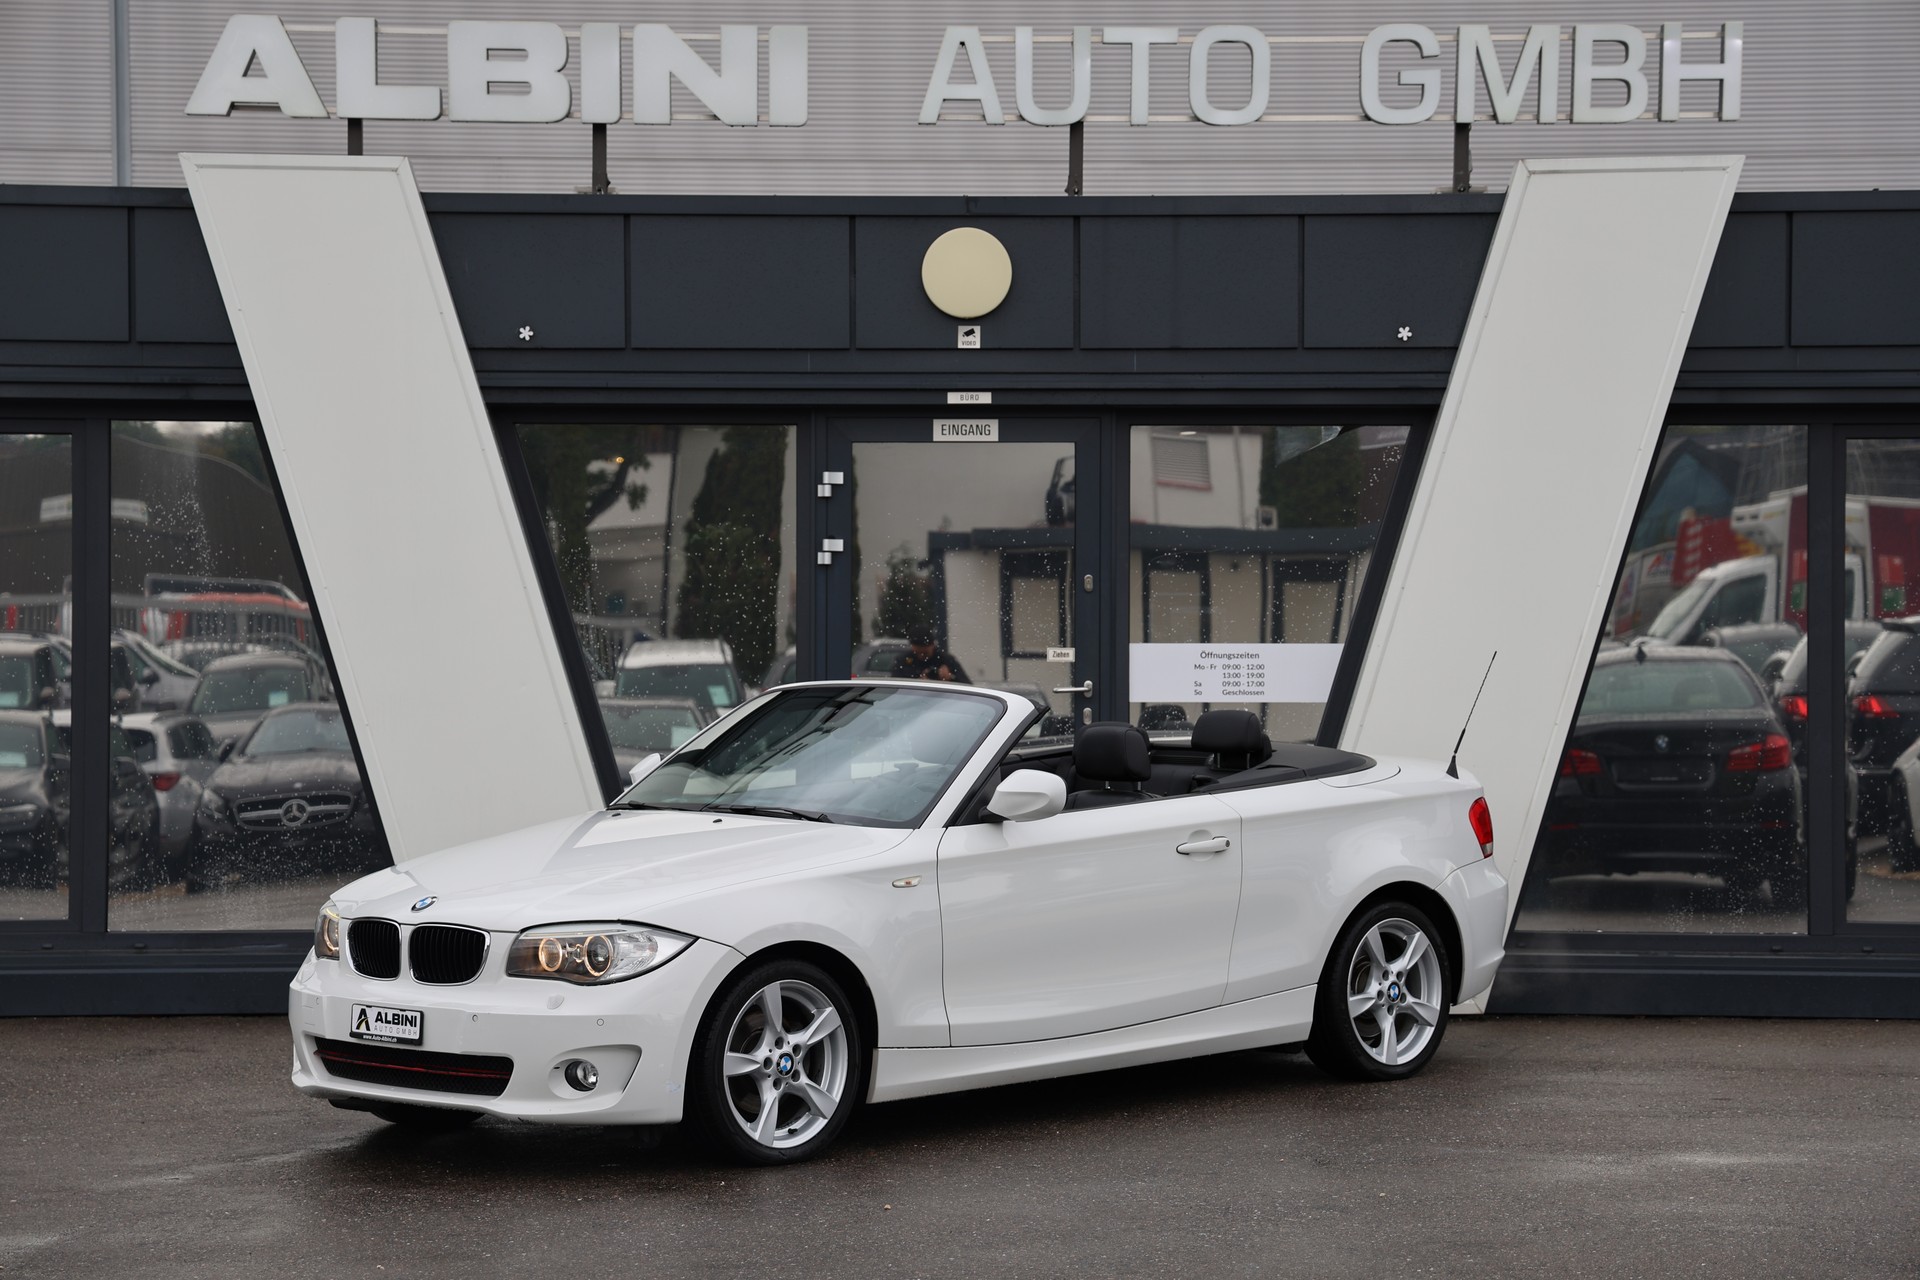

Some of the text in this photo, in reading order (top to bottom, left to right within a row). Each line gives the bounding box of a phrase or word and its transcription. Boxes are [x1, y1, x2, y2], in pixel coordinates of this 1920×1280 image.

[184, 14, 1743, 127] ALBINI AUTO GMBH
[941, 424, 991, 436] EINGANG
[1052, 650, 1070, 658] Ziehen
[1200, 650, 1260, 660] Öffnungszeiten
[374, 1011, 417, 1027] ALBINI
[374, 1025, 417, 1036] AUTO GMBH
